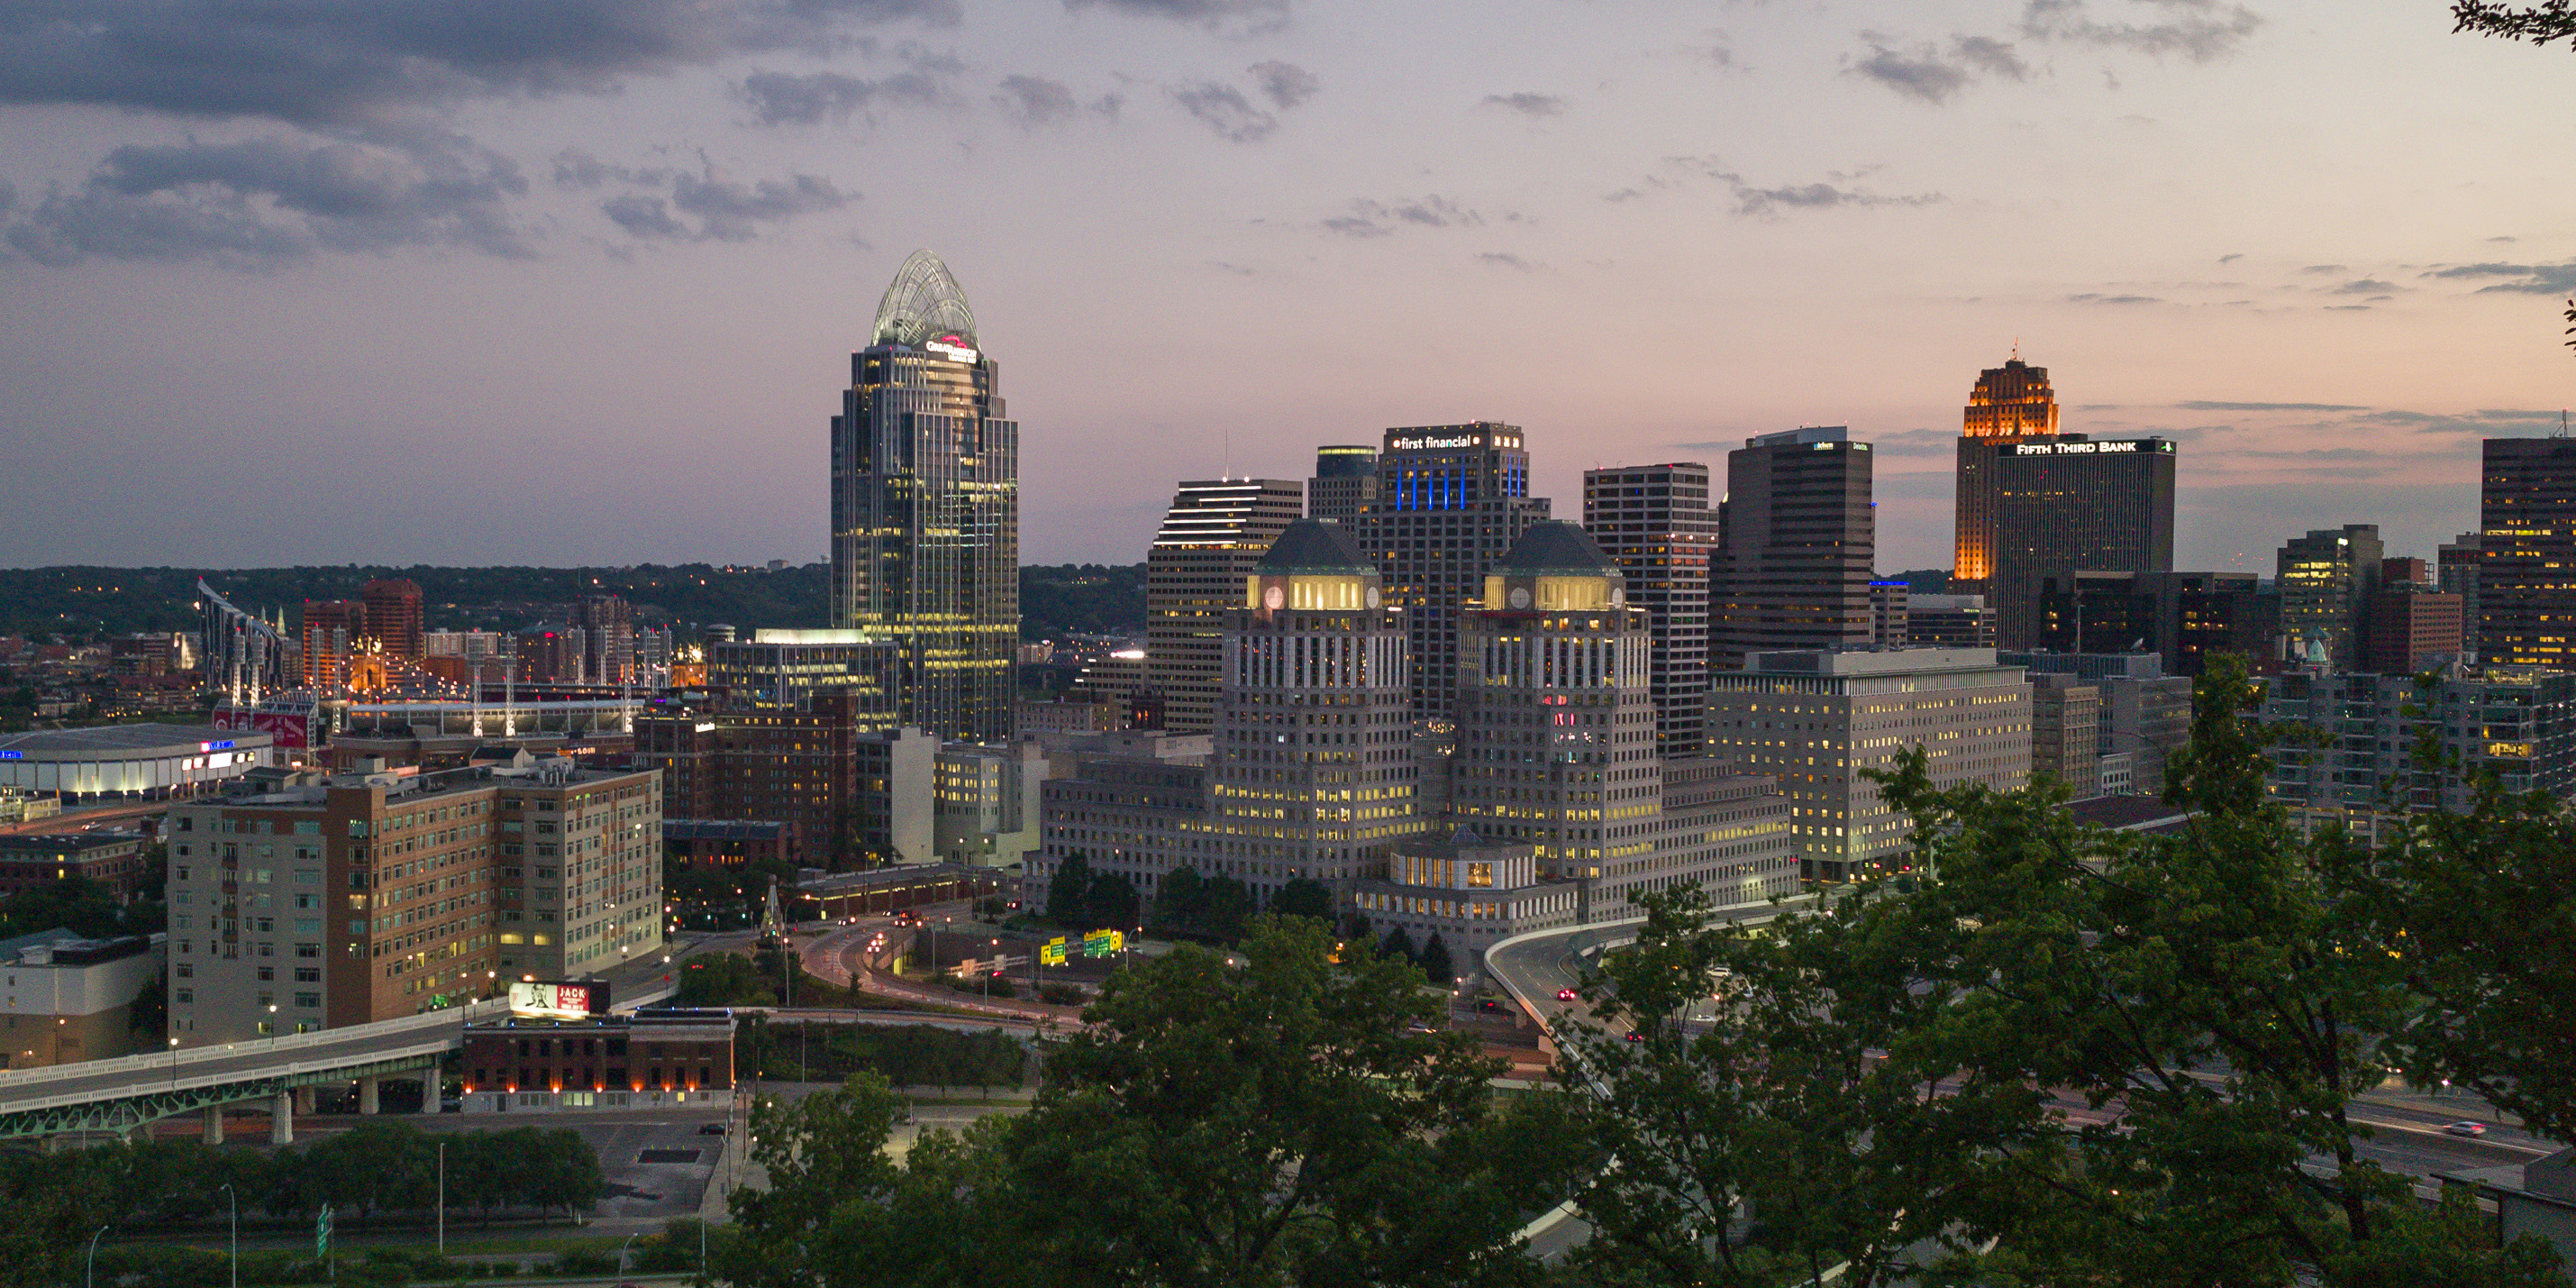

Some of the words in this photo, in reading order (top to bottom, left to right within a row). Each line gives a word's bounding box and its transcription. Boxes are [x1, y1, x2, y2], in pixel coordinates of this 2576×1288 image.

[1400, 437, 1423, 450] first
[1425, 434, 1470, 449] financial
[2016, 444, 2052, 455] FIFTH
[2055, 443, 2096, 453] THIRD
[2098, 442, 2136, 452] BANK
